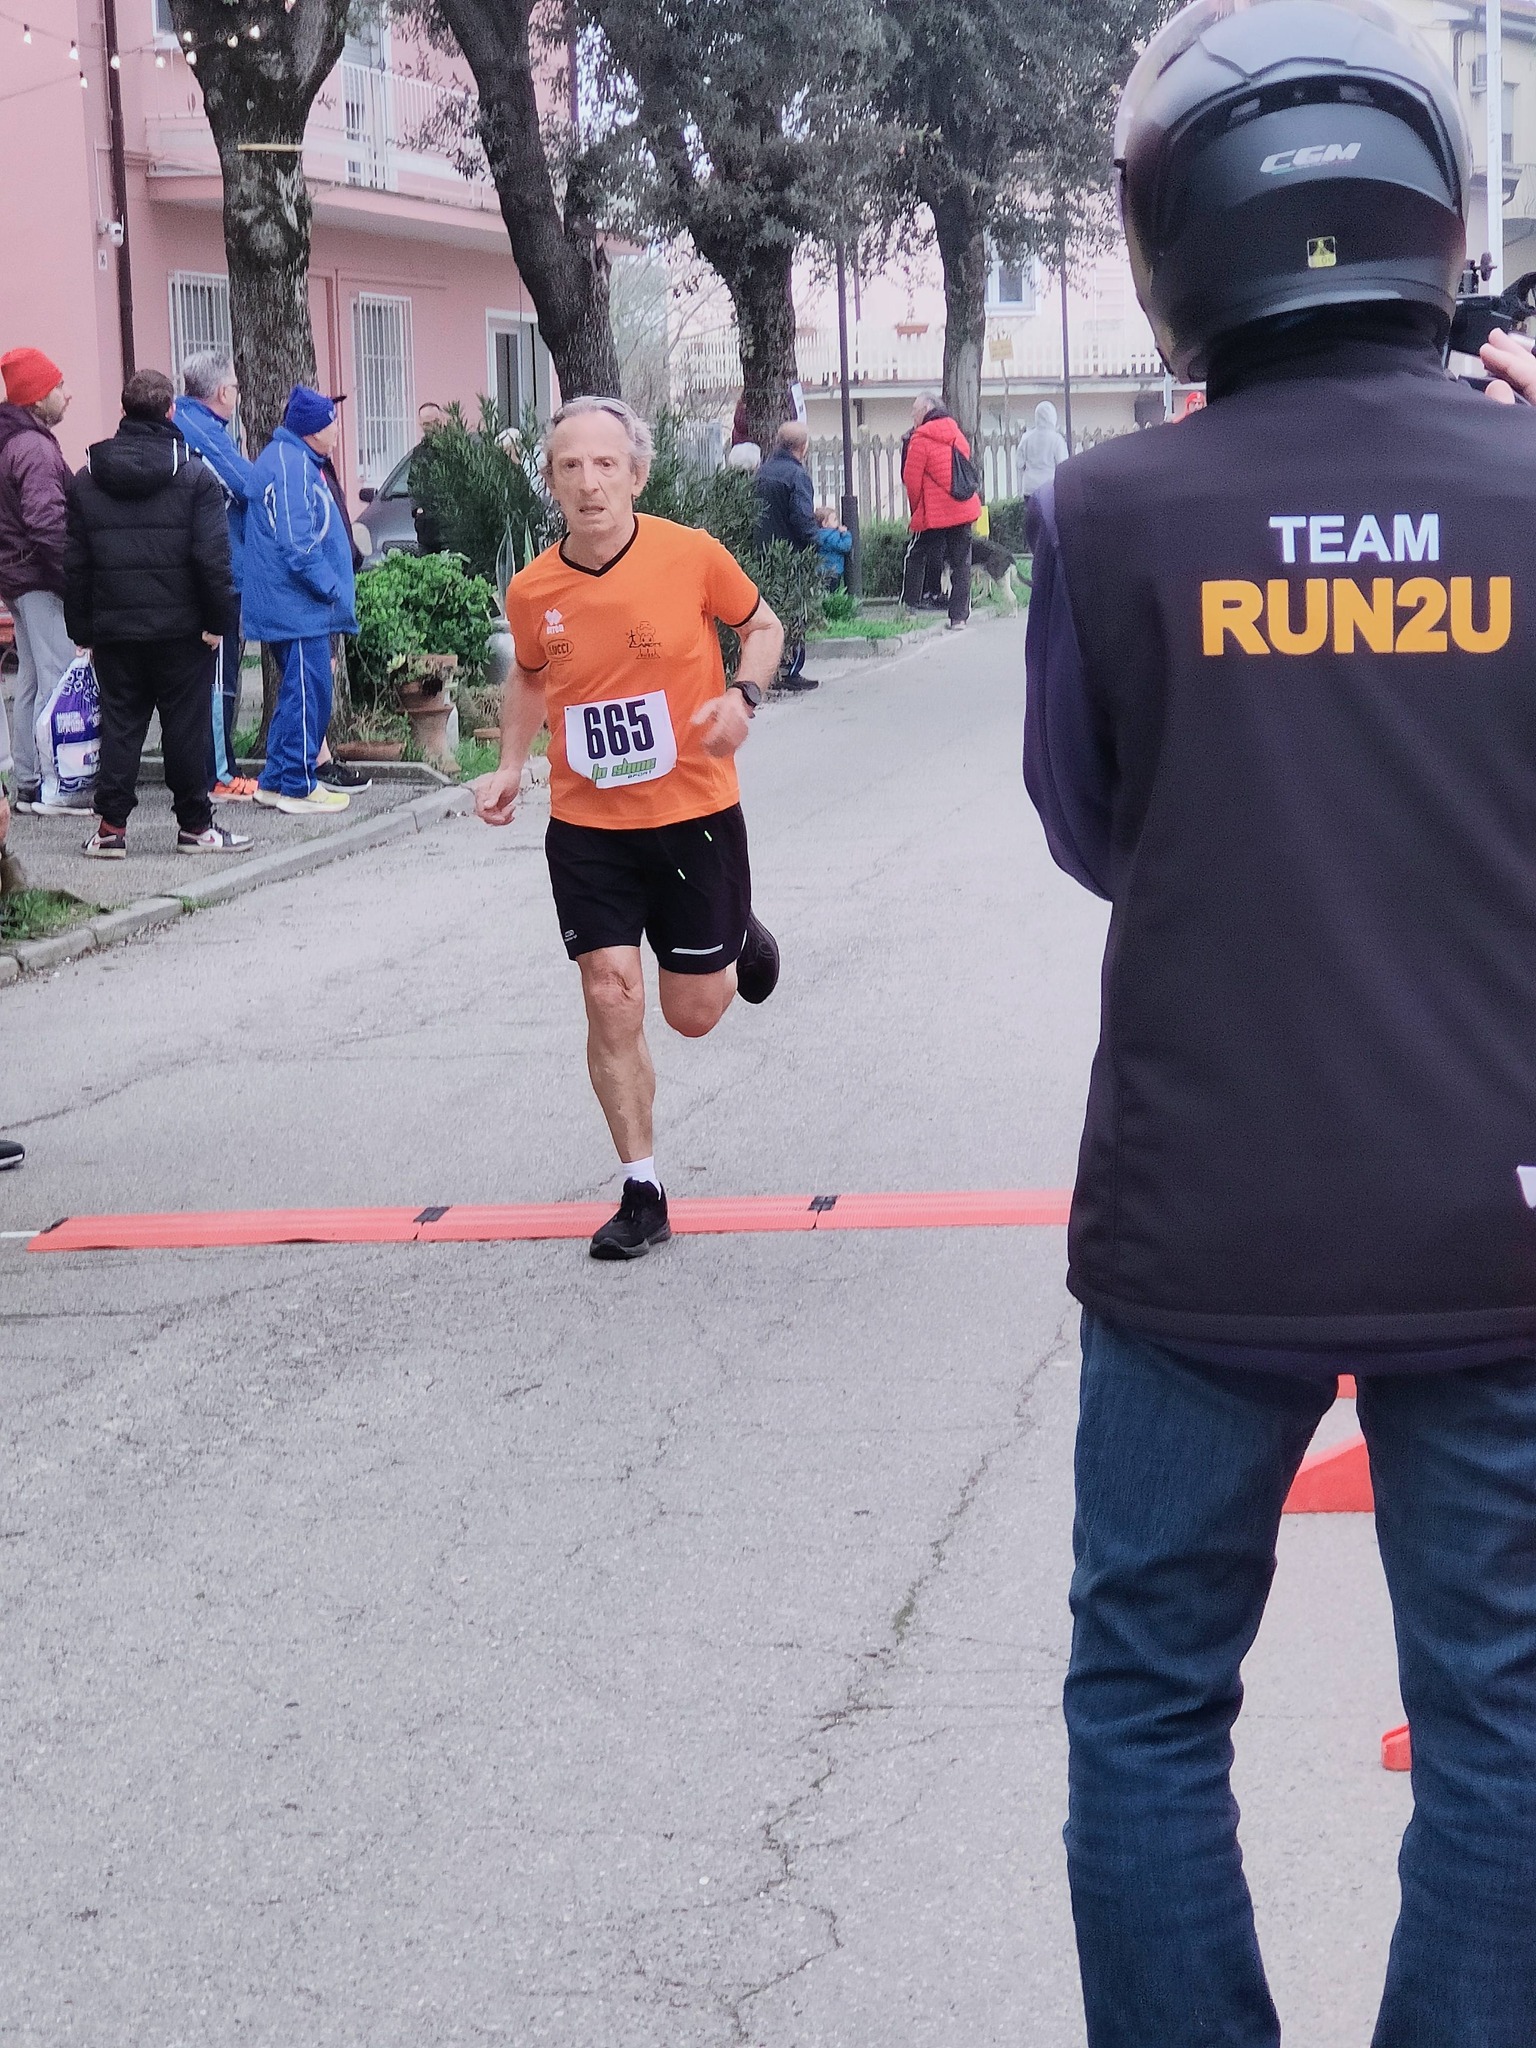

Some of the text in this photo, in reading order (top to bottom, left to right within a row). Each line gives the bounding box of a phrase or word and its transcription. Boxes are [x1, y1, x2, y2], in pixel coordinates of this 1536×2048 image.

[1260, 143, 1361, 173] CGM
[1269, 513, 1440, 563] TEAM
[1202, 576, 1512, 656] RUN2U
[583, 699, 654, 759] 665
